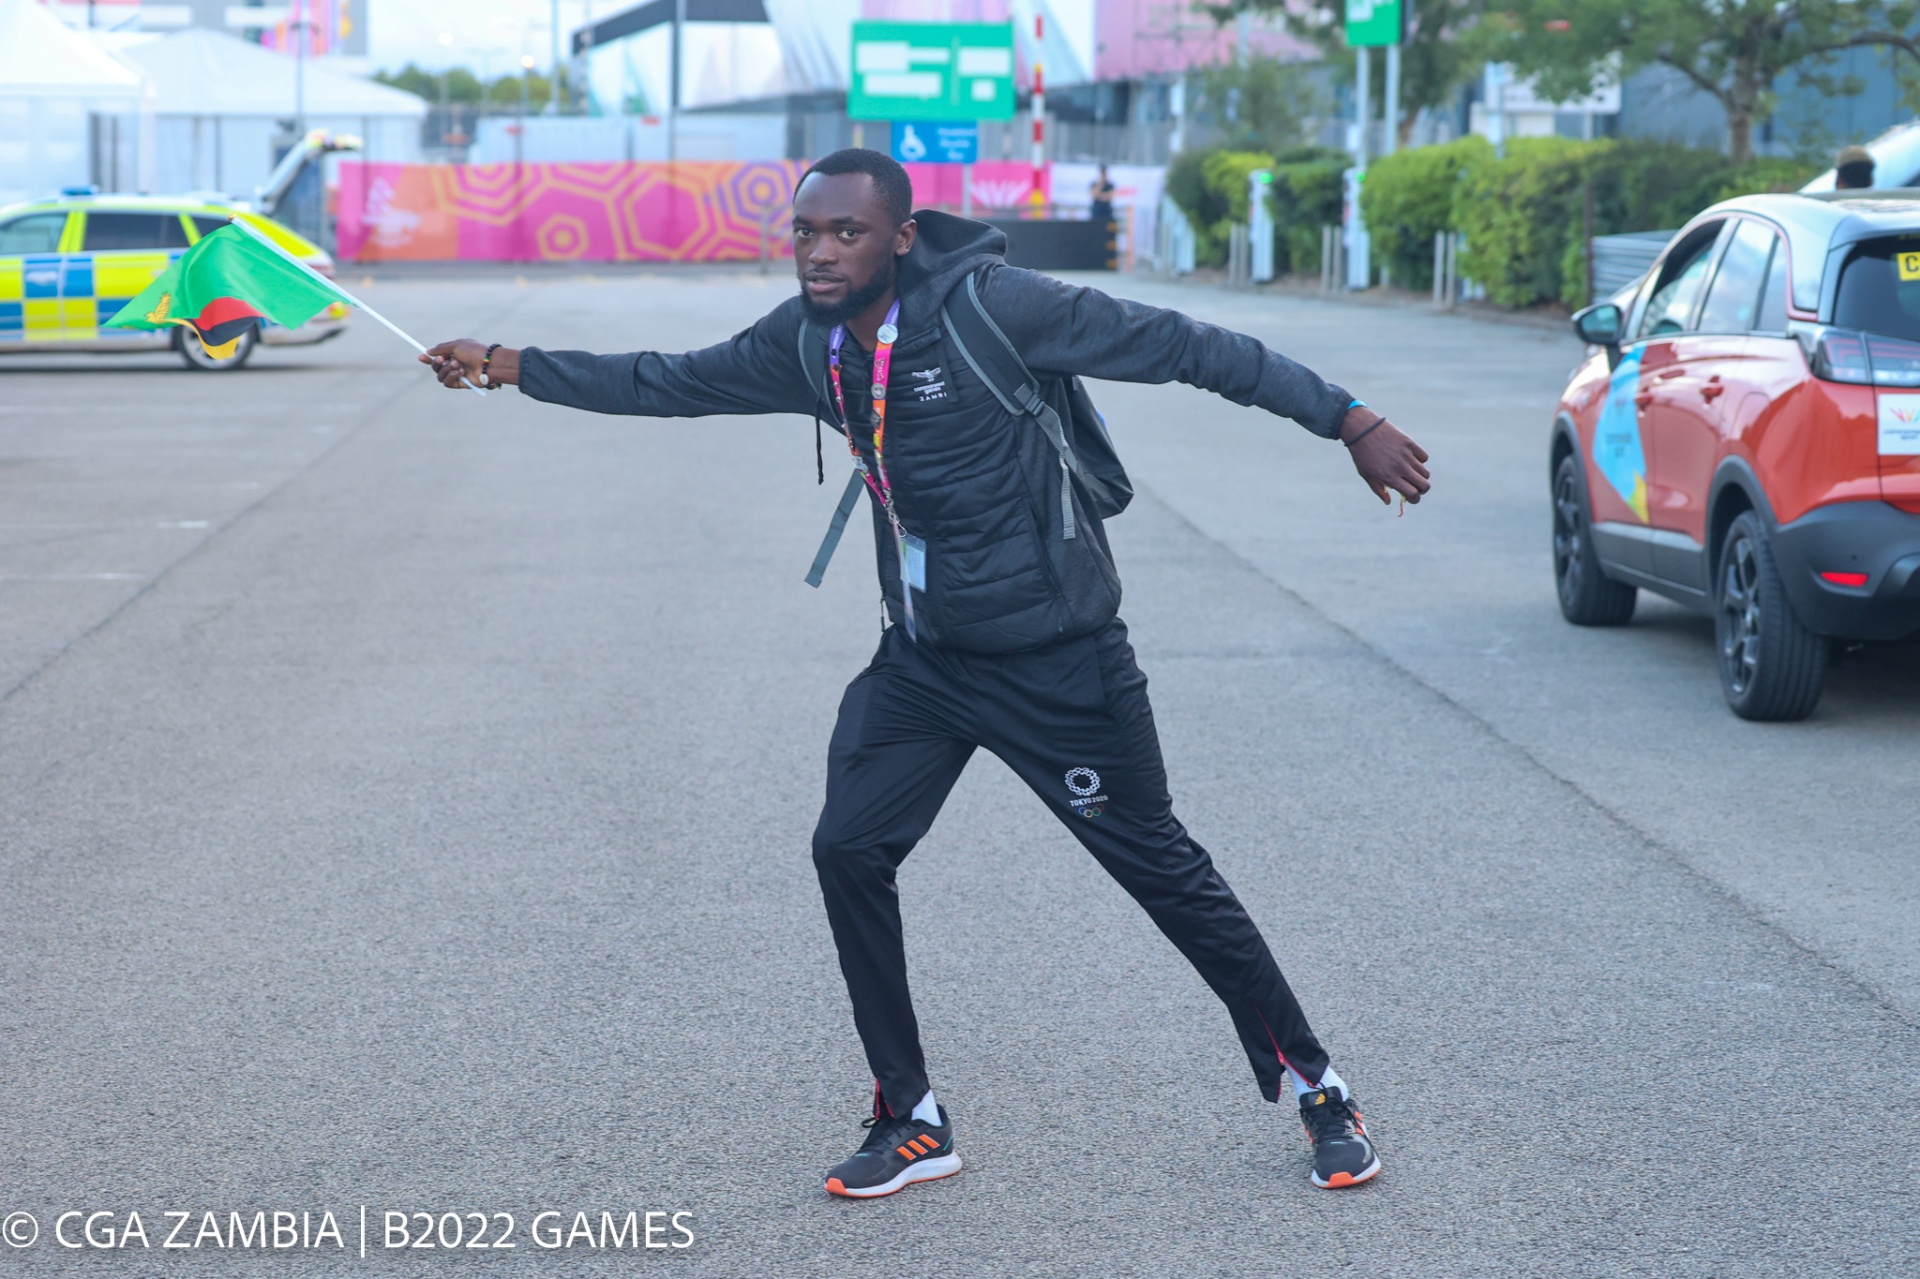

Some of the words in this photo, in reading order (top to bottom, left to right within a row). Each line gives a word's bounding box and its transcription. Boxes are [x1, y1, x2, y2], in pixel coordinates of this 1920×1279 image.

[919, 392, 947, 401] ZAMBI
[1069, 798, 1091, 807] TOKYO
[1092, 795, 1108, 803] 2020
